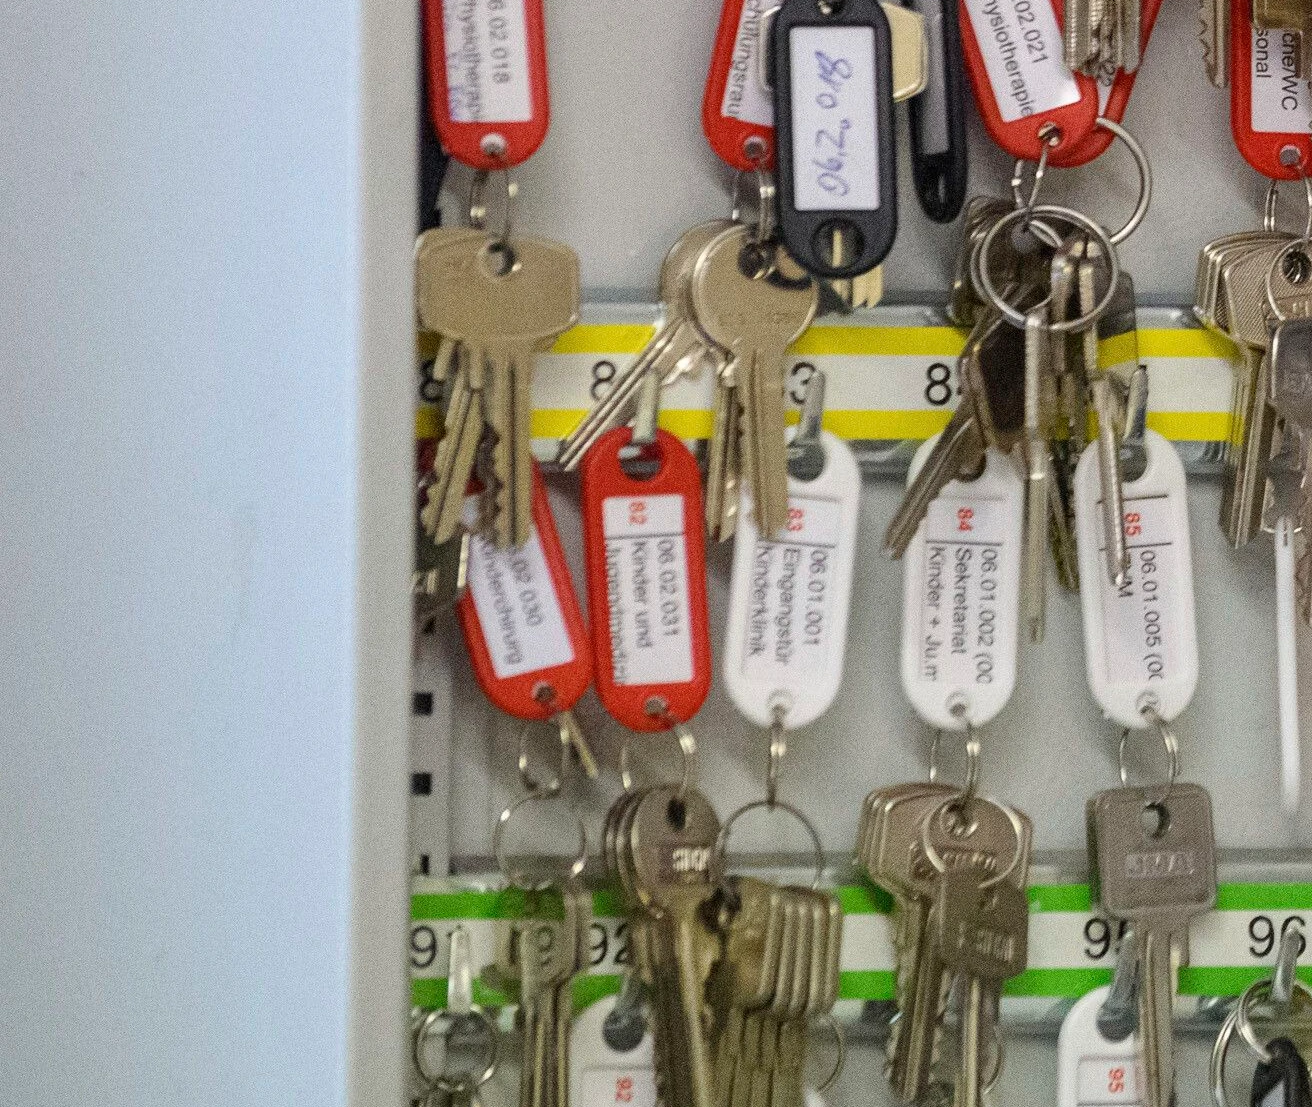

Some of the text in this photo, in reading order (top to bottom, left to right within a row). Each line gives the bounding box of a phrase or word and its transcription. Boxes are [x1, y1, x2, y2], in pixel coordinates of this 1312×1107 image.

[1124, 513, 1140, 537] 85
[951, 548, 970, 654] Sekretariat
[977, 547, 996, 648] 06.01.002
[1140, 550, 1161, 648] 06.01.005
